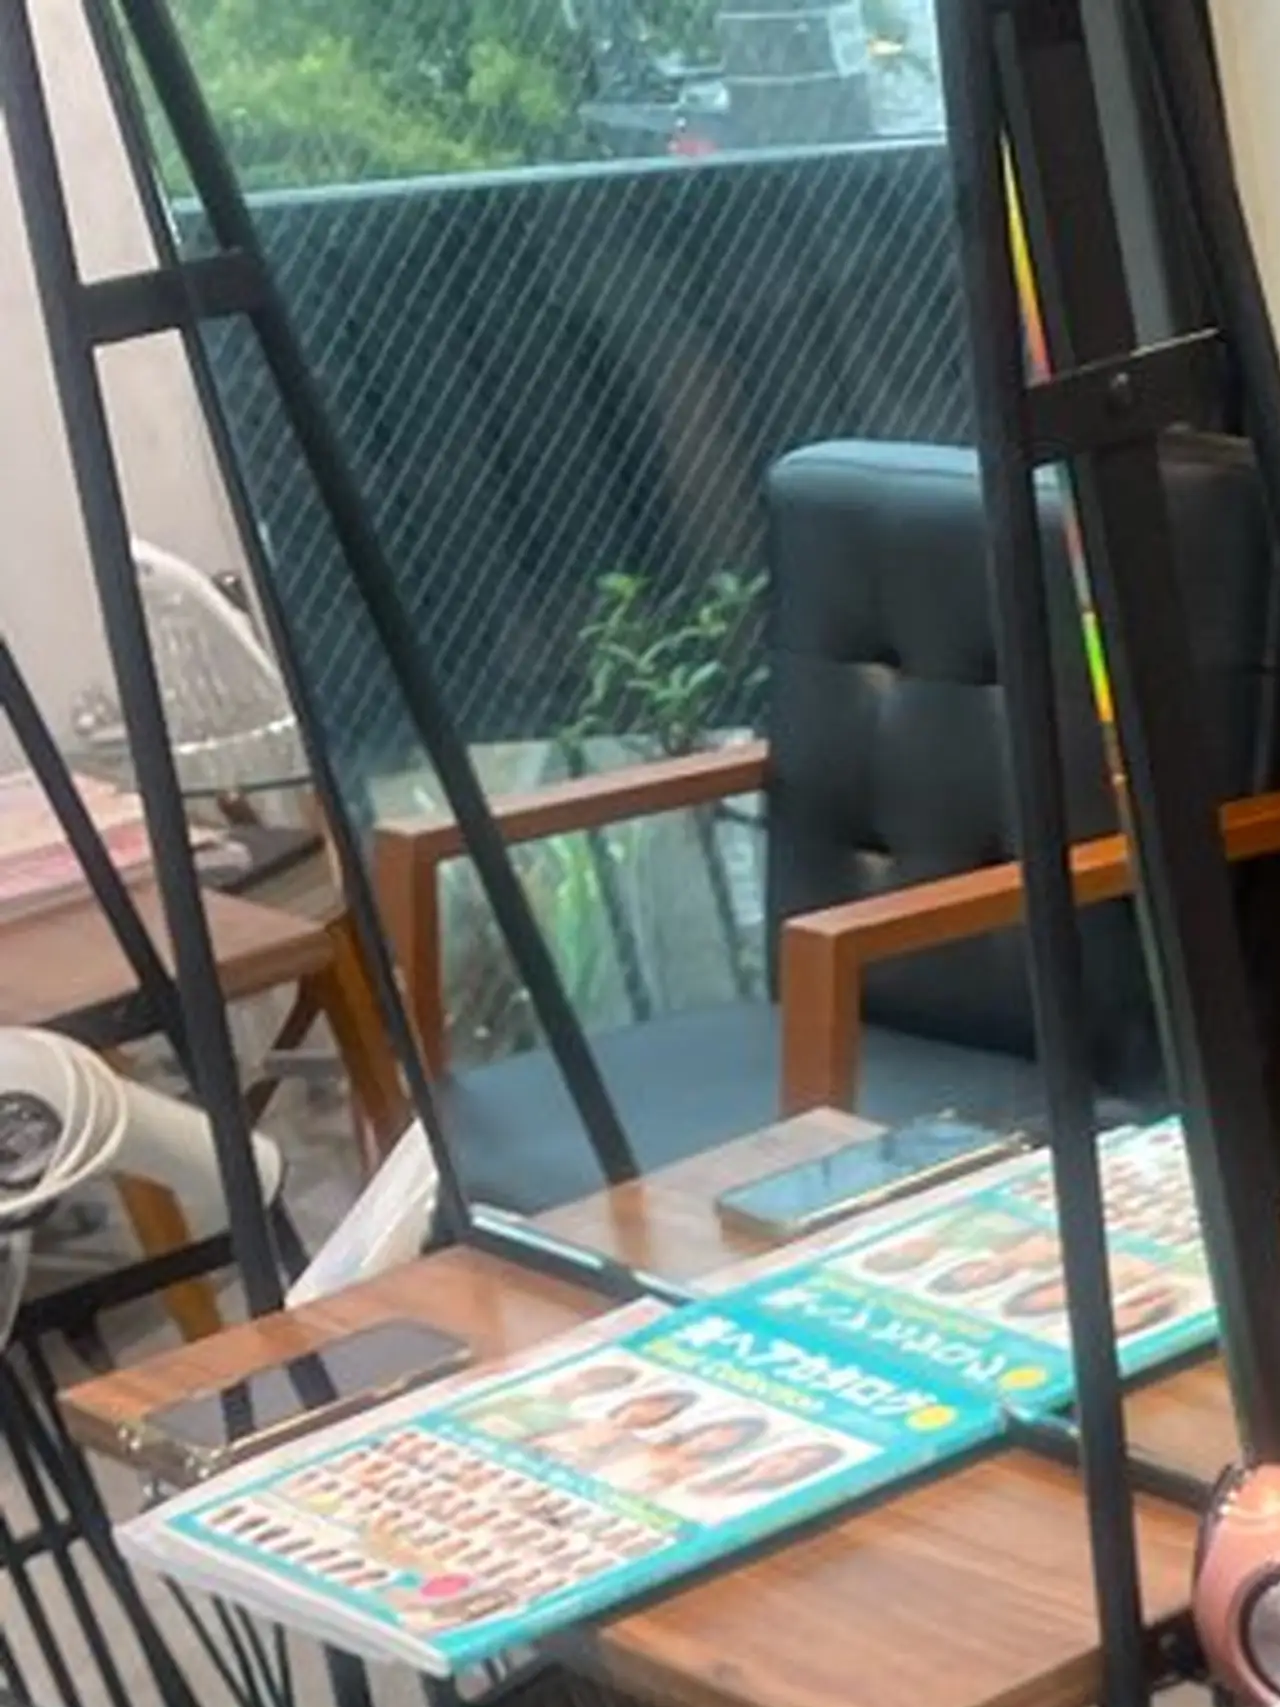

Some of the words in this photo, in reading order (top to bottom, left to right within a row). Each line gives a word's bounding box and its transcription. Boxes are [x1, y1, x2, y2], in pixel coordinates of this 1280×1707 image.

[675, 1315, 944, 1416] ヘアカタログ
